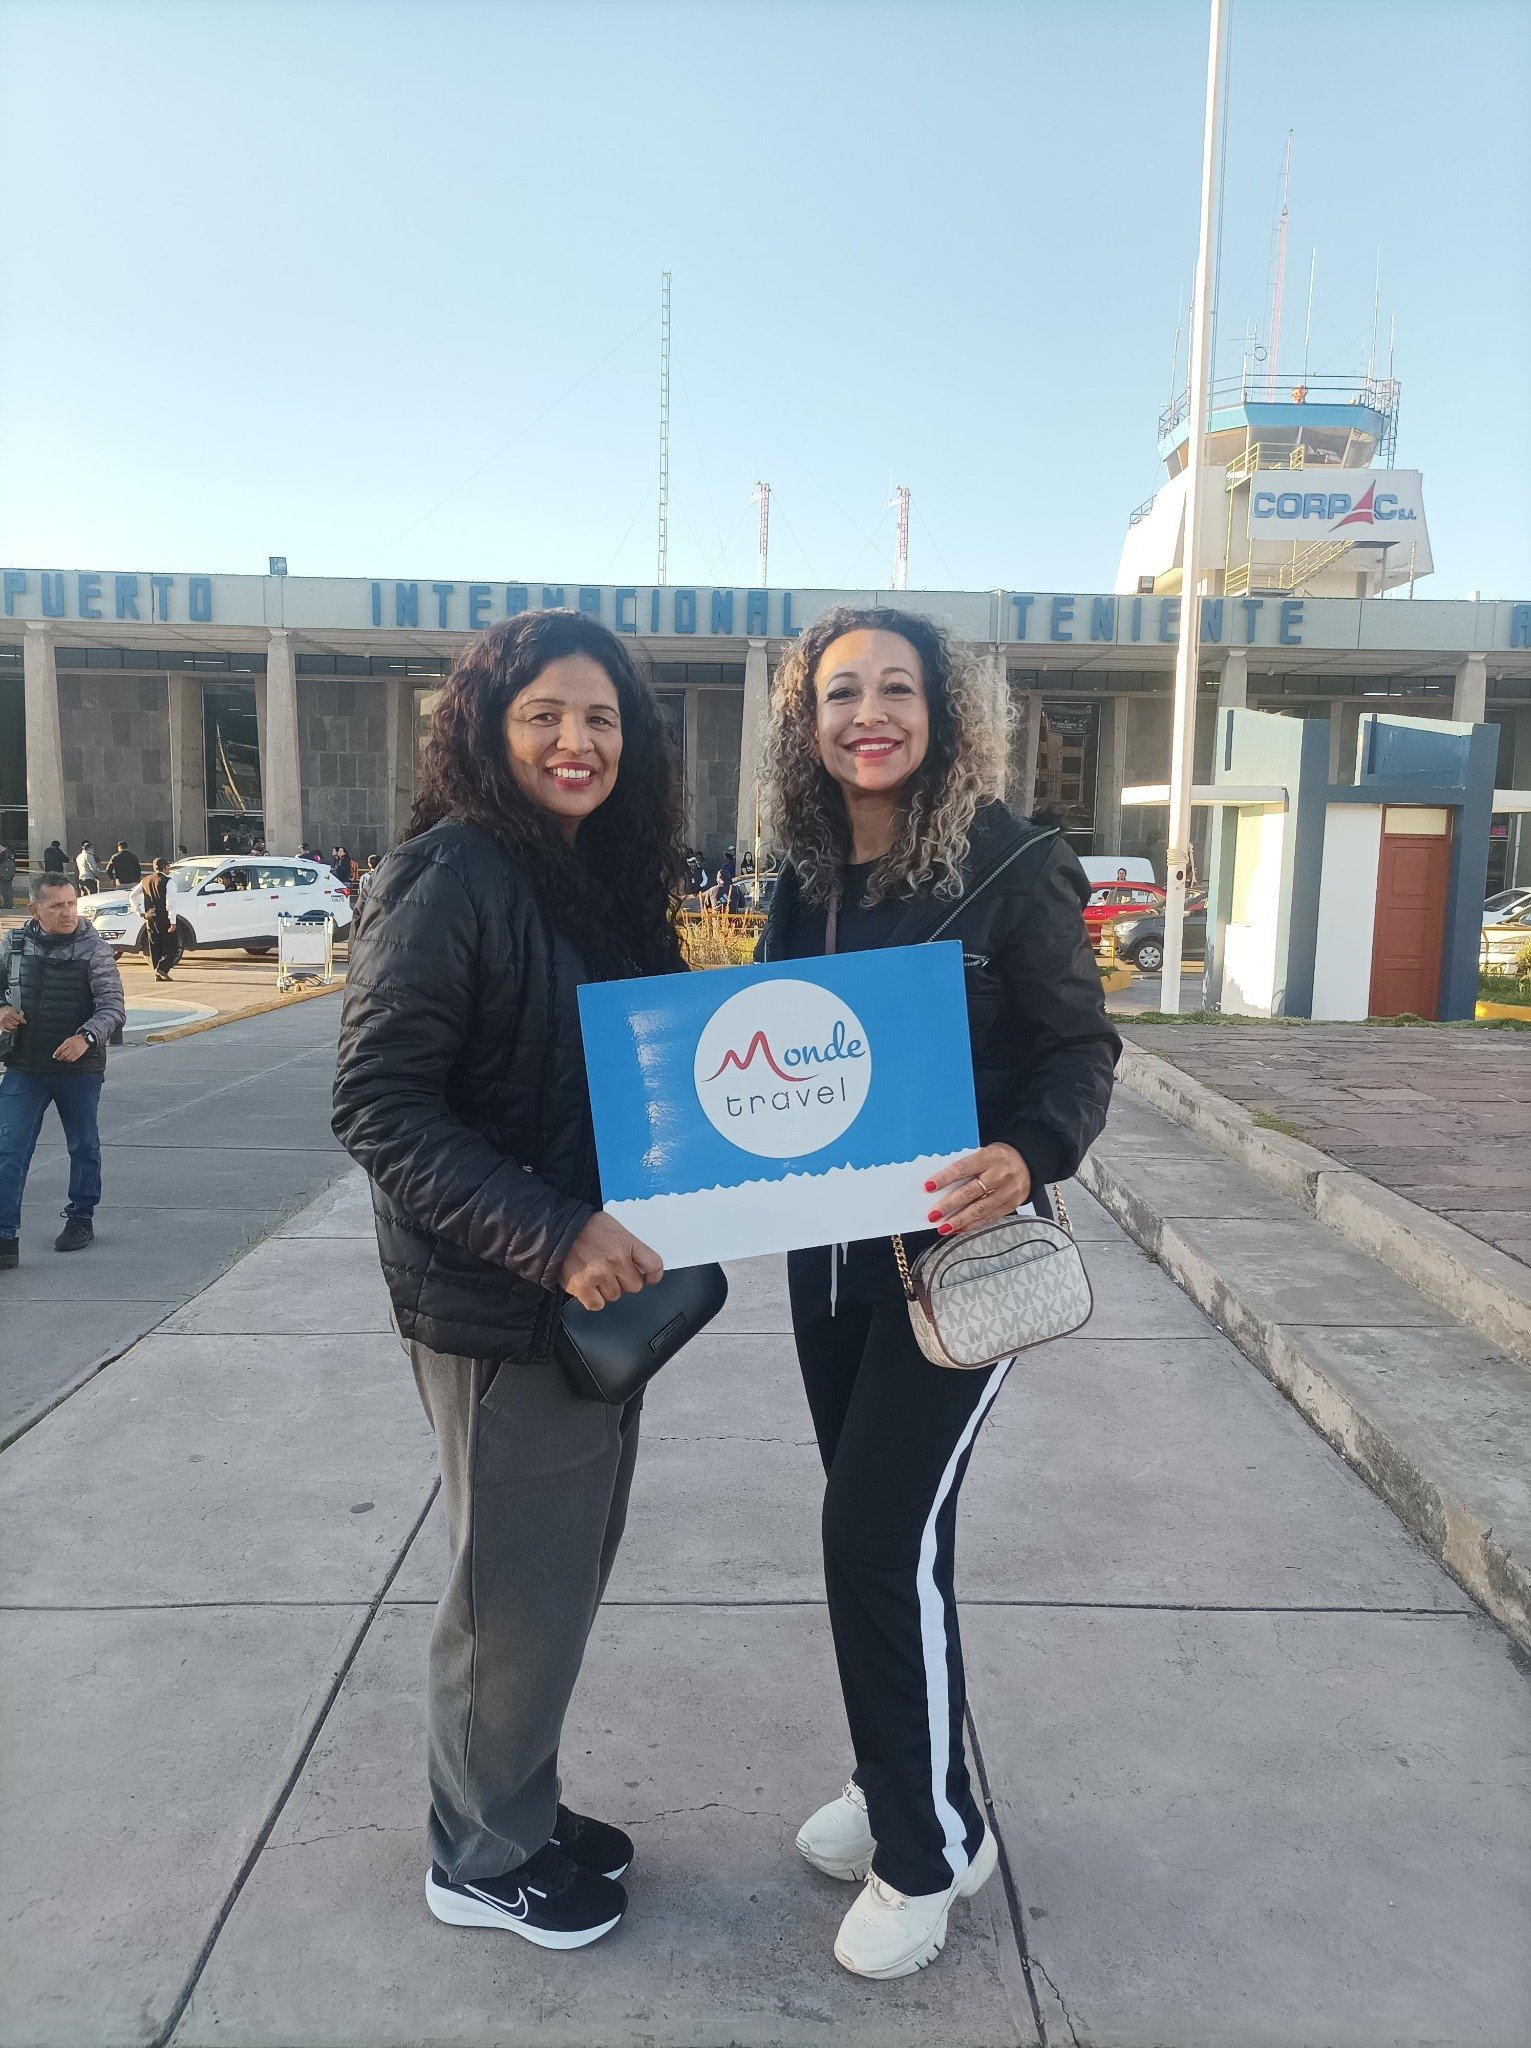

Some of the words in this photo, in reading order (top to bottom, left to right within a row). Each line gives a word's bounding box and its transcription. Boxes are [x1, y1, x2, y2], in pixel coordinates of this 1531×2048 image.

[1253, 480, 1398, 531] CORPAC
[4, 572, 212, 621] PUERTO
[1012, 596, 1304, 645] TENIENTE
[701, 1021, 866, 1082] Monde
[726, 1077, 847, 1117] travel
